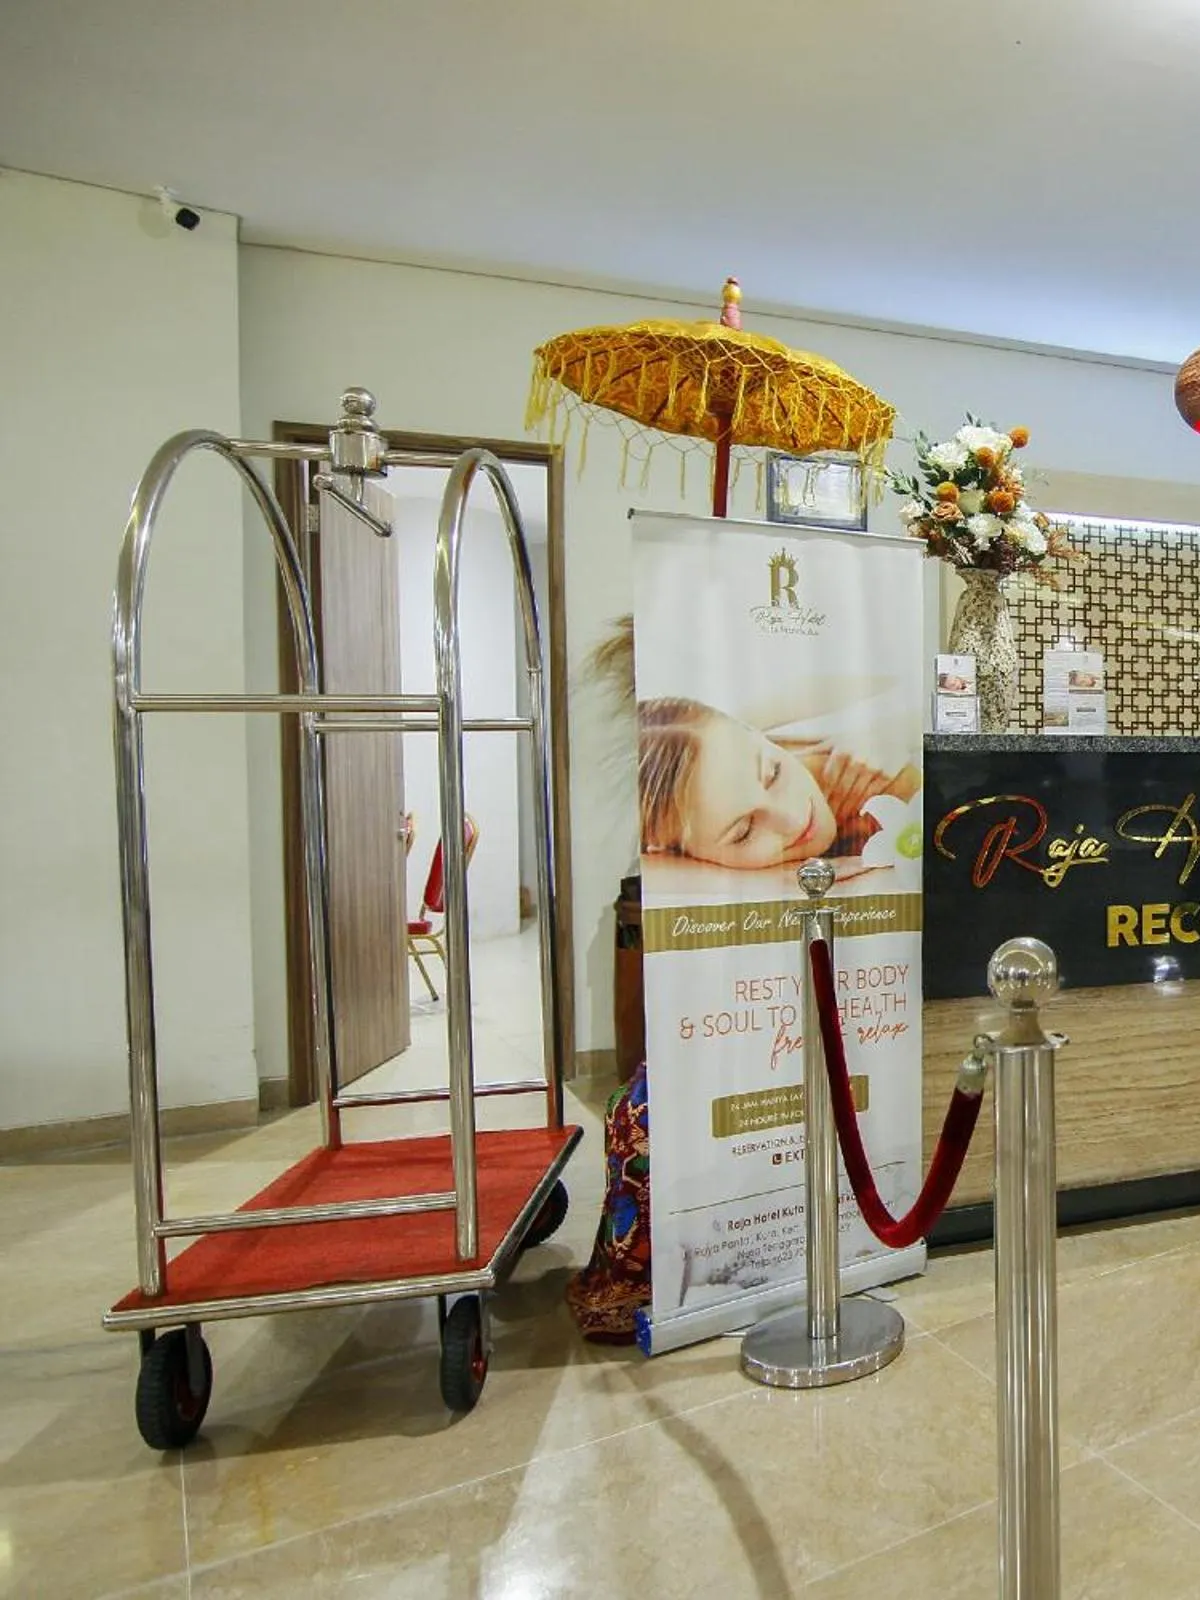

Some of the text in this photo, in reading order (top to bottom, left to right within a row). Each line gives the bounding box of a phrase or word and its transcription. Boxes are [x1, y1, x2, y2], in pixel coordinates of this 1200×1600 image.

[933, 795, 1111, 888] Raja
[672, 915, 736, 937] Discover
[743, 910, 772, 931] Our
[778, 908, 802, 929] Ne
[735, 963, 909, 1003] REST YR BODY
[703, 1008, 763, 1037] SOUL
[767, 1004, 797, 1028] TO
[728, 1218, 752, 1231] Raja
[754, 1209, 780, 1224] Hotel
